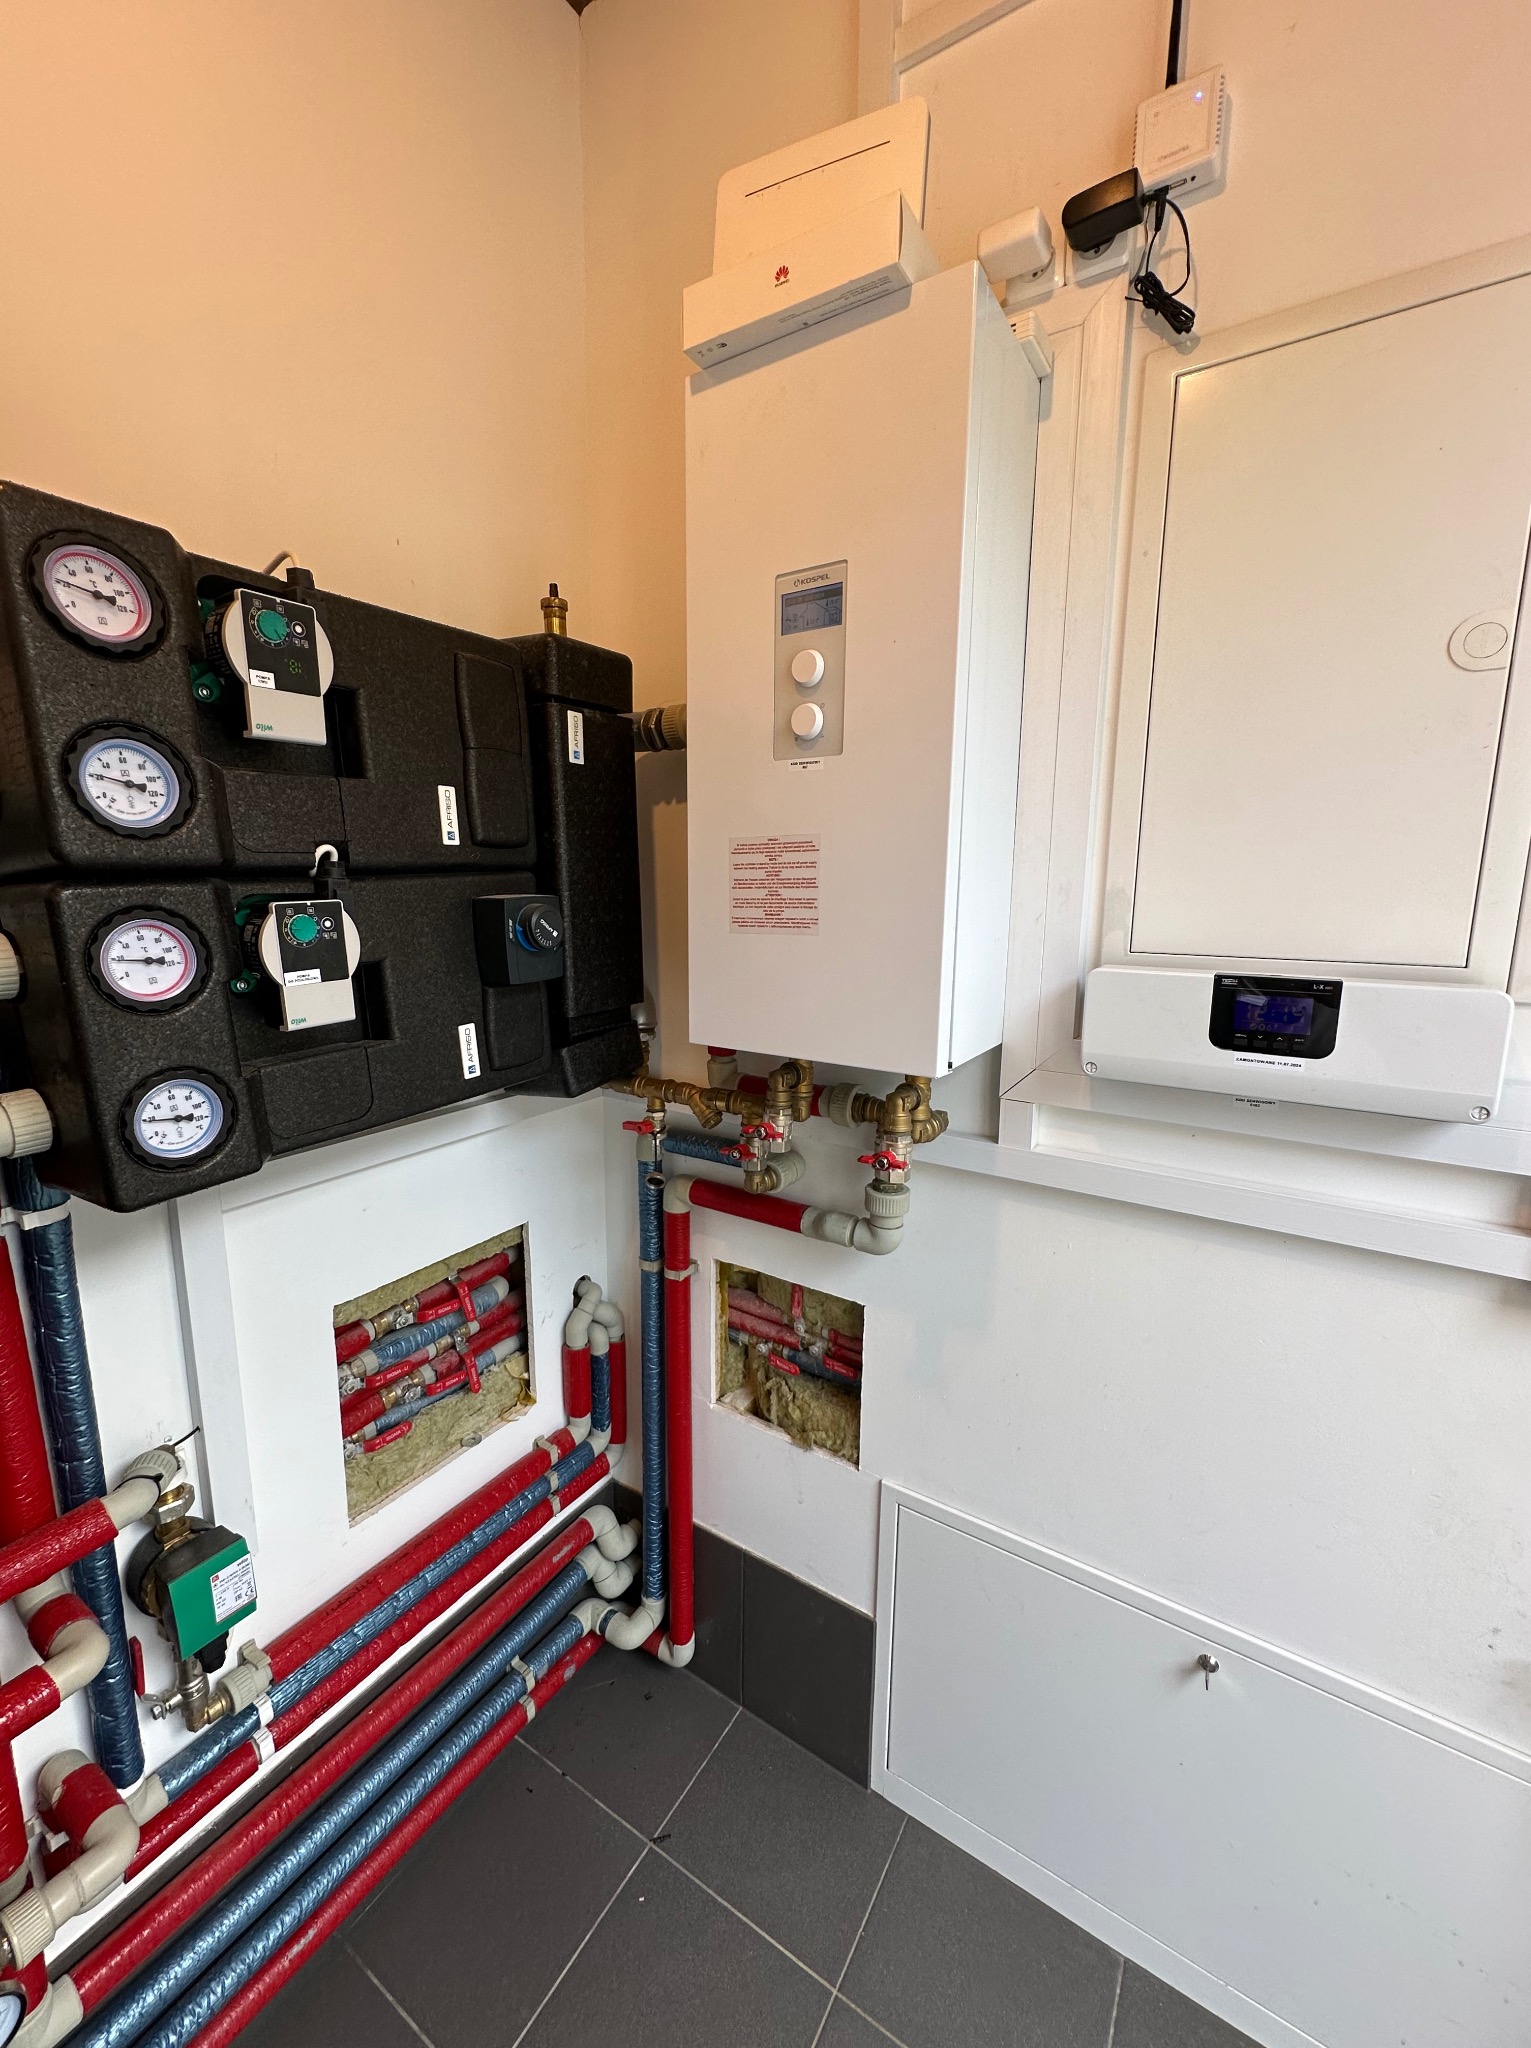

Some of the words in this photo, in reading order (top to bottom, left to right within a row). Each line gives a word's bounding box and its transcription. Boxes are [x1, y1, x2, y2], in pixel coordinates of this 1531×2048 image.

[800, 573, 831, 586] KOSPEL
[255, 723, 273, 732] wilo
[444, 789, 454, 829] AFRISO
[290, 1017, 307, 1026] wilo
[464, 1027, 474, 1063] AFRISO
[1235, 1057, 1276, 1065] ZAMONTOWANE
